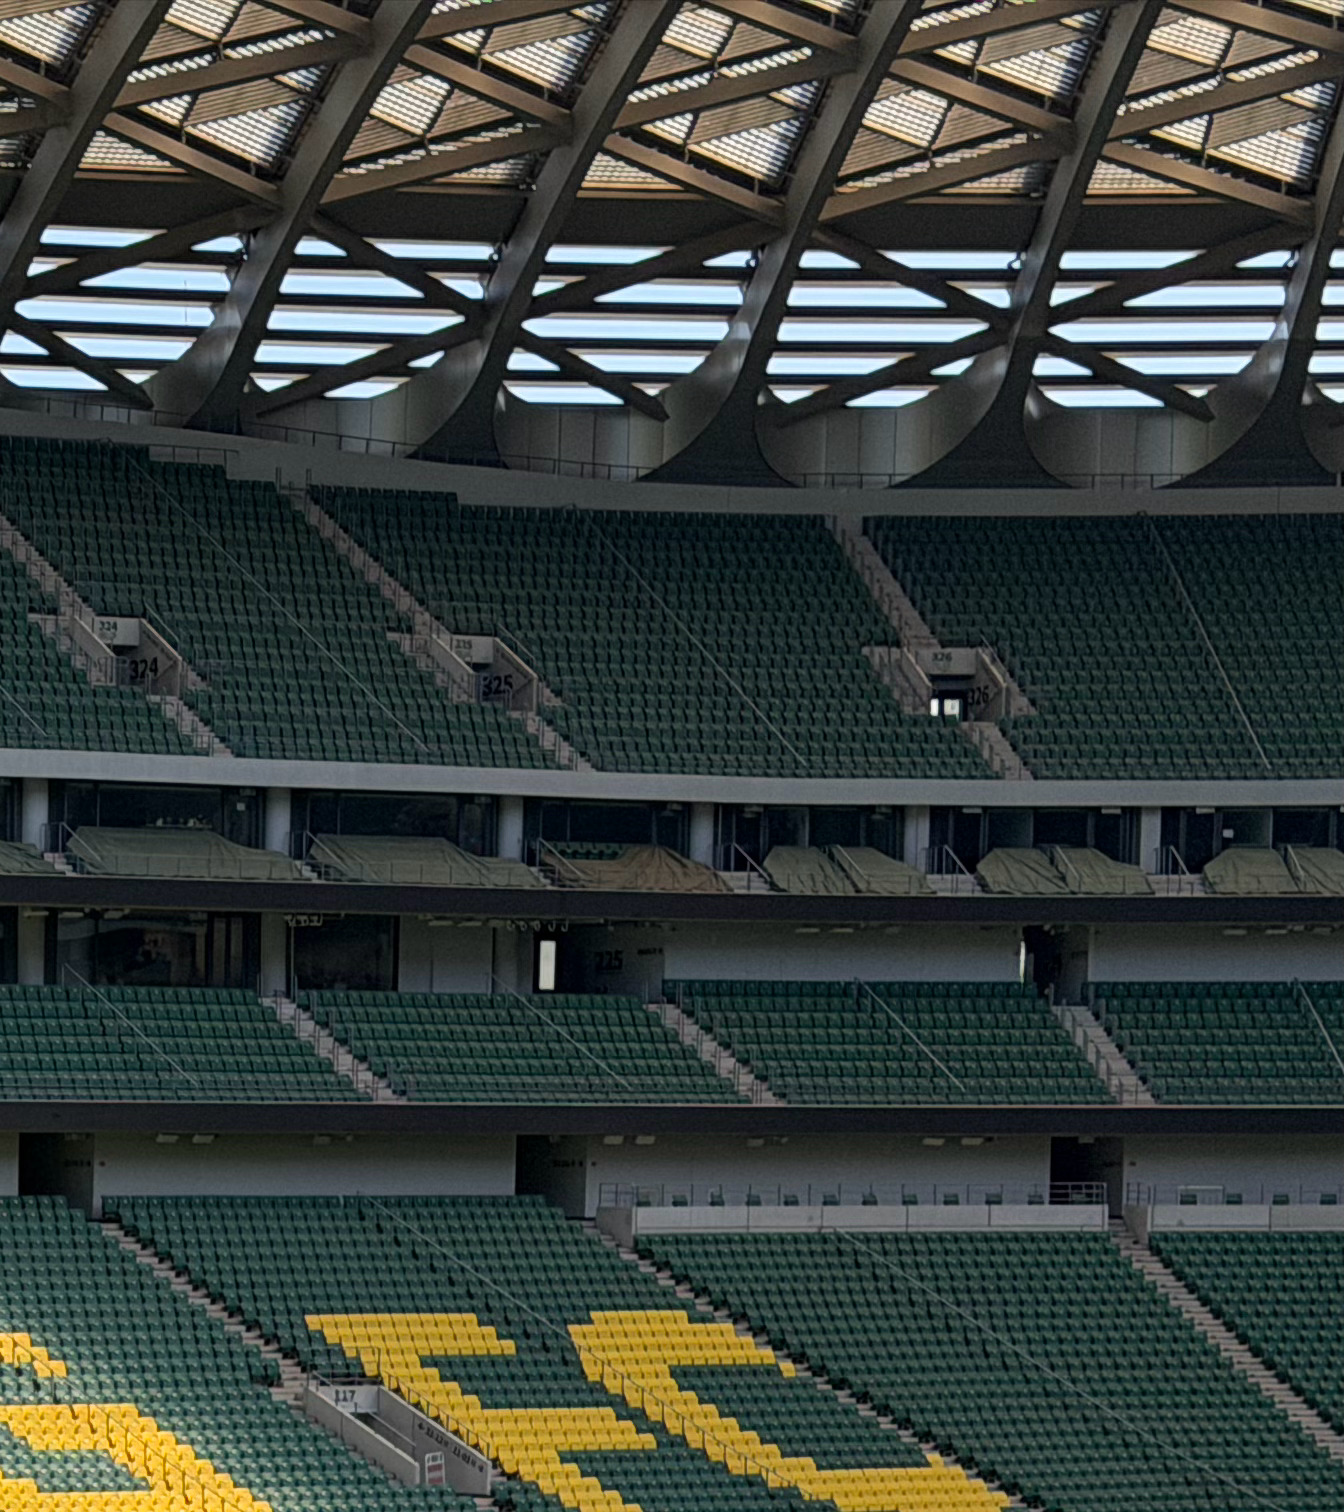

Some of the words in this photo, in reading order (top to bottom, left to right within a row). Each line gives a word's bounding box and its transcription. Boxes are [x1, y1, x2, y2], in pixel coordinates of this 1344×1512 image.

[129, 657, 159, 680] 324
[482, 675, 513, 697] 325
[334, 1389, 356, 1403] 117
